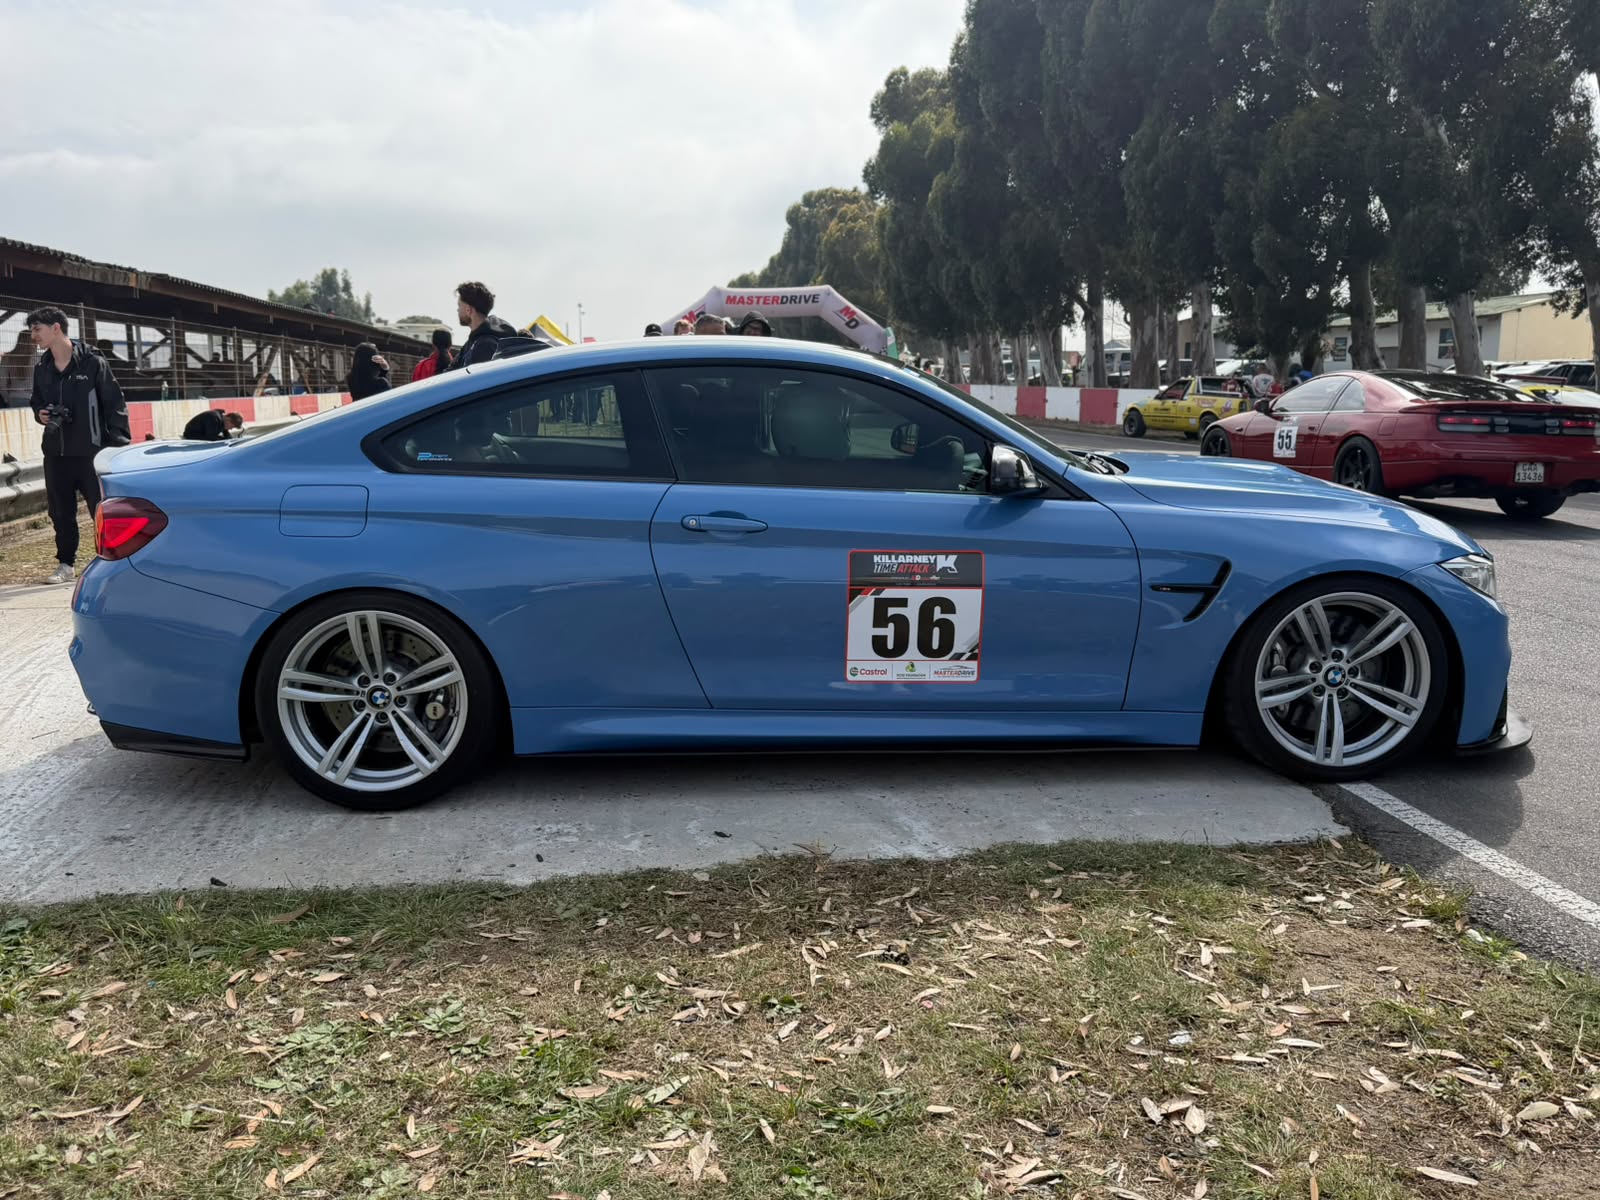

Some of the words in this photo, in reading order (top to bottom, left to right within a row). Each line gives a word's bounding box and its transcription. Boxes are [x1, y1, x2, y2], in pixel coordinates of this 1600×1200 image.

[725, 293, 821, 306] MASTERDRIVE
[1277, 429, 1293, 450] 55
[1516, 472, 1543, 481] 13436
[873, 554, 937, 564] KILLARNEY
[873, 563, 898, 574] TIME
[897, 563, 930, 574] ATTACK
[872, 596, 957, 659] 56
[859, 668, 888, 676] Castrol
